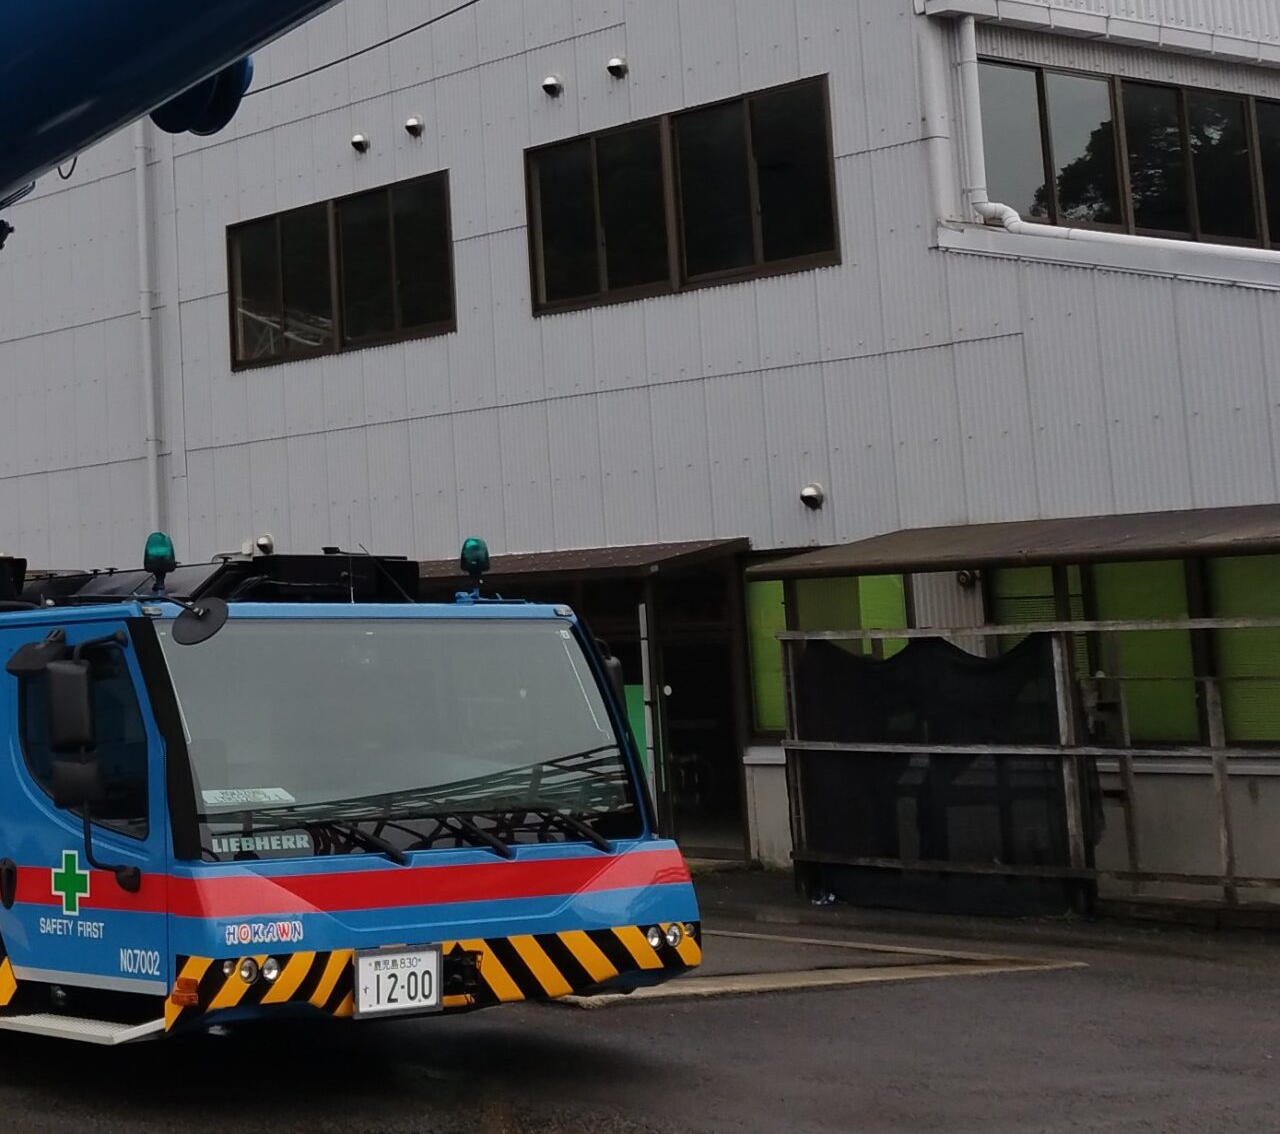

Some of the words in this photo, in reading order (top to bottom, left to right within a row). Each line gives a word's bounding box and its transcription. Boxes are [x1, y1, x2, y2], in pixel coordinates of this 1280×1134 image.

[211, 834, 310, 853] LIEBHERR
[39, 917, 74, 935] SAFETY
[77, 920, 105, 939] FIRST
[225, 921, 304, 945] HOKAWN
